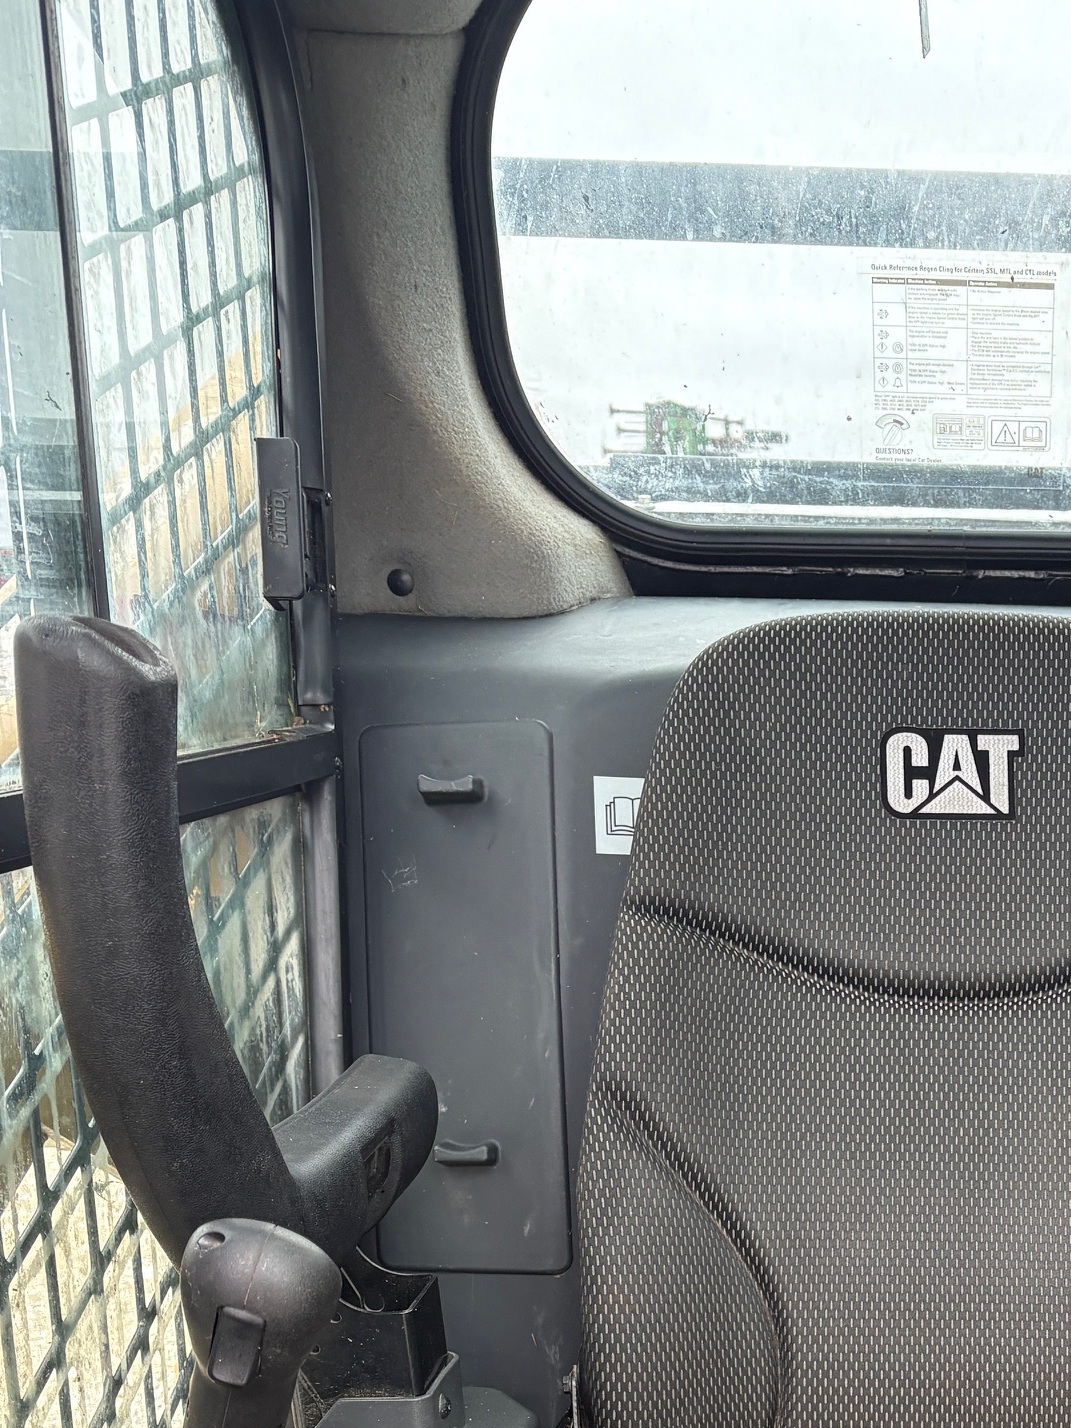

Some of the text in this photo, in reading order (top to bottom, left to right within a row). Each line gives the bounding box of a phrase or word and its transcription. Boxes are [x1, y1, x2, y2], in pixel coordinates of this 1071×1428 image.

[871, 263, 887, 271] Quick
[889, 264, 918, 272] Reference
[919, 265, 937, 273] Regen
[938, 266, 954, 274] Cling
[963, 266, 985, 274] Certain
[875, 447, 914, 455] QUESTIONS?
[1027, 466, 1045, 478] CAT
[271, 488, 291, 547] Young
[885, 731, 1020, 815] CAT
